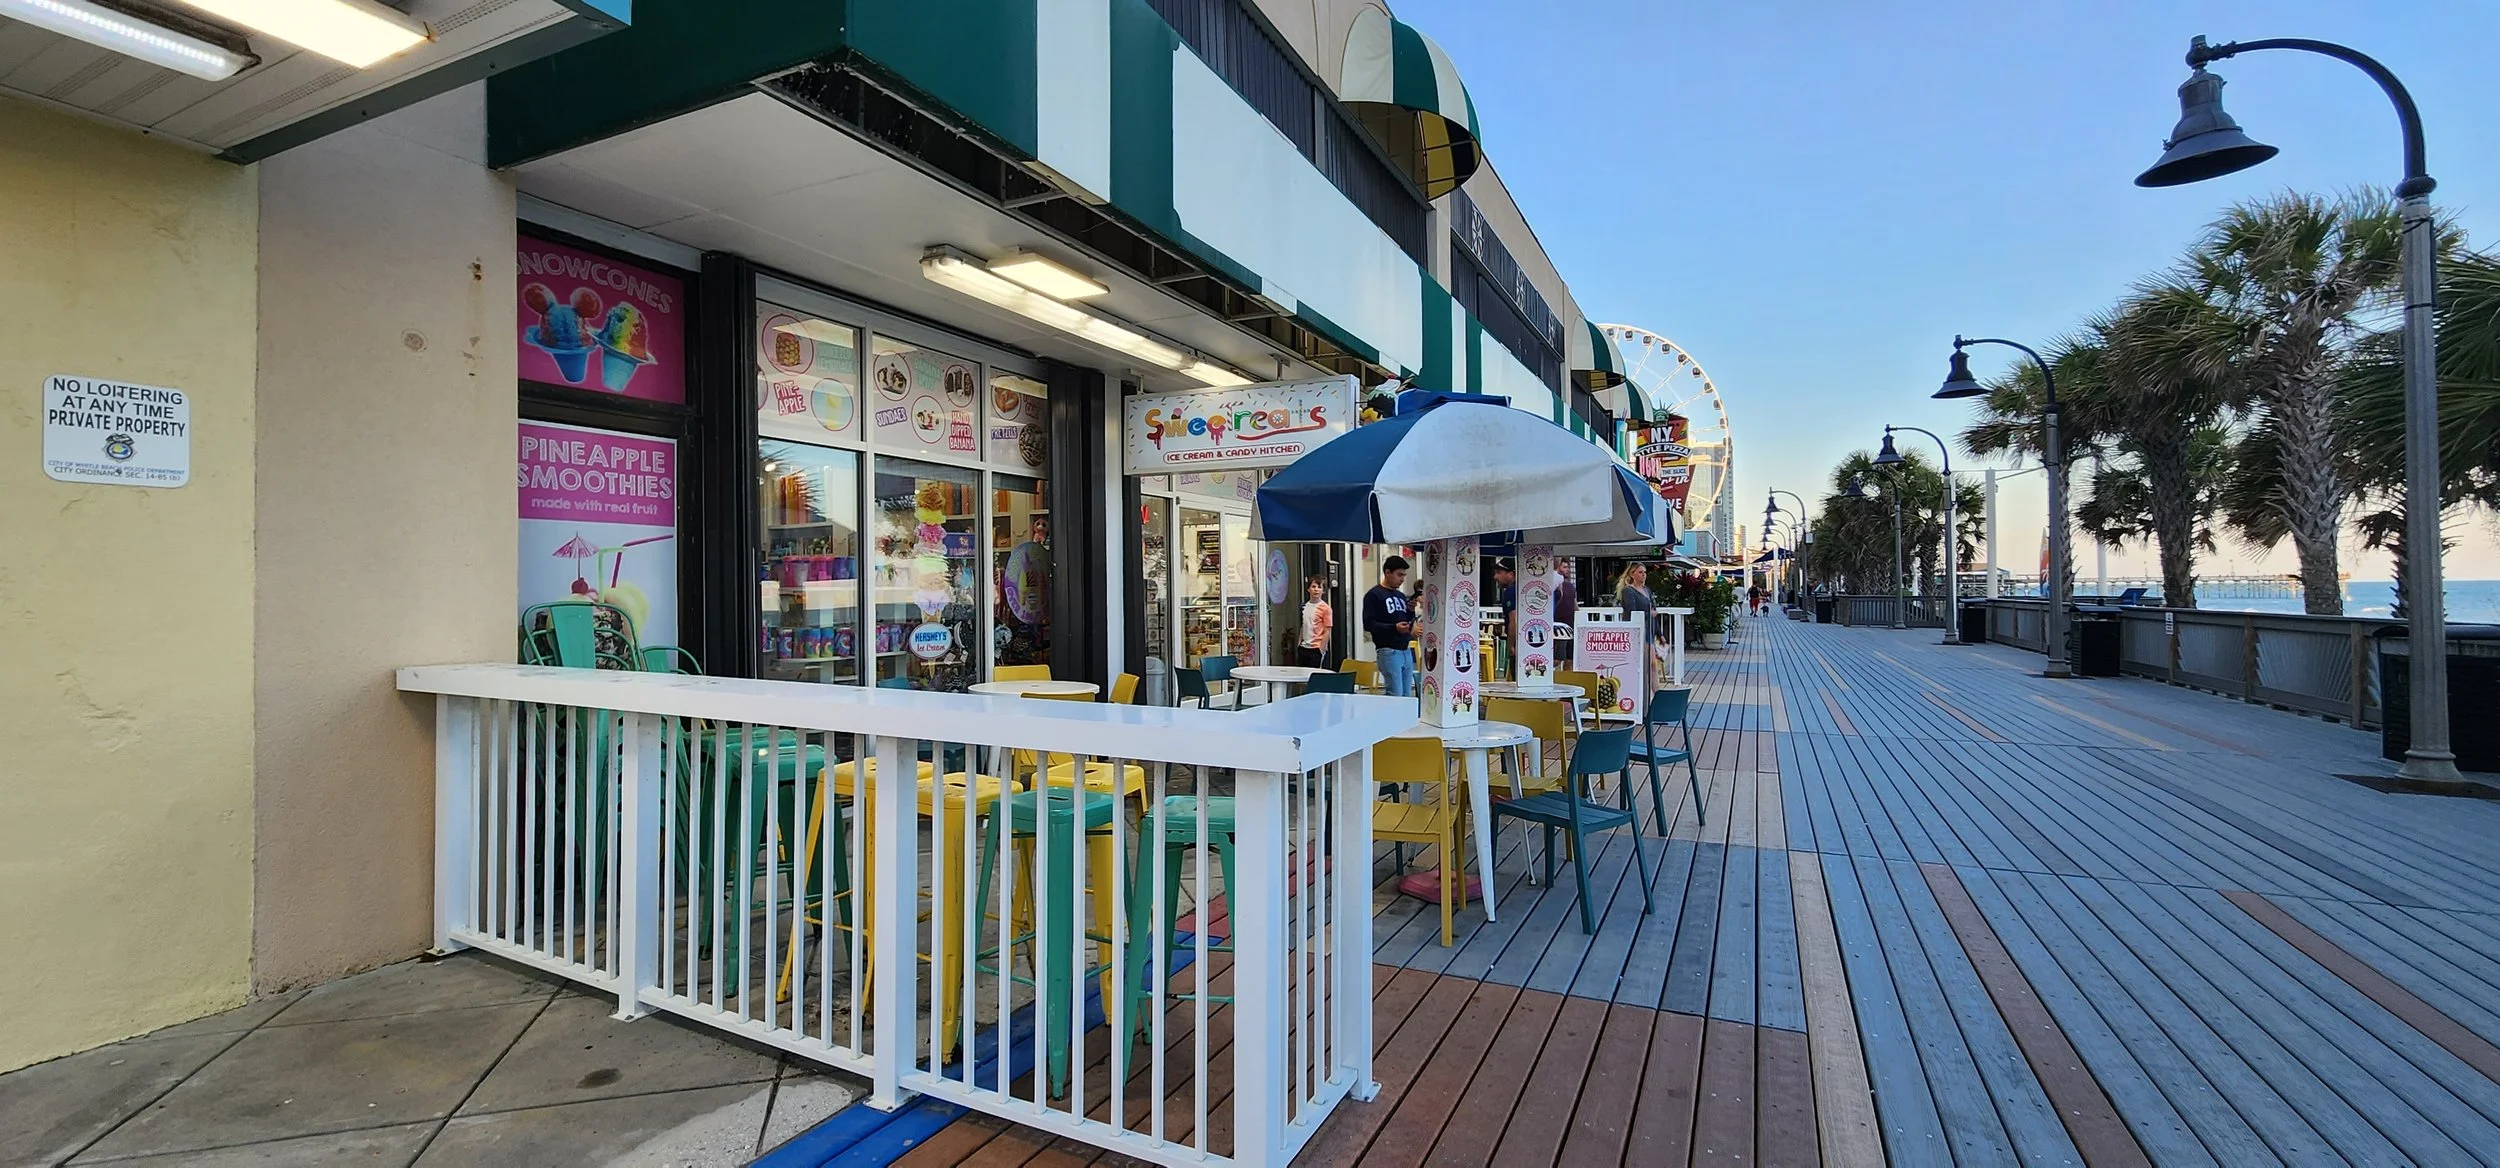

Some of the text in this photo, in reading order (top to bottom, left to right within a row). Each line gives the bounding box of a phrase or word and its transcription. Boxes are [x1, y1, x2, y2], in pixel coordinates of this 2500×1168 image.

[53, 377, 183, 405] NO LOITERING
[774, 380, 800, 399] PINE-
[61, 395, 174, 419] AT ANY TIME
[779, 396, 806, 416] APPLE
[49, 409, 186, 437] PRIVATE PROPERTY
[875, 407, 907, 427] SUNDAES
[949, 437, 975, 450] BANANA
[1651, 426, 1674, 443] N.Y.
[521, 436, 666, 474] PINEAPPLE
[1166, 444, 1300, 461] ICE CREAM & CANDY KITCHEN
[1664, 445, 1689, 455] PIZZA
[518, 463, 673, 499] SMOOTHIES
[531, 497, 658, 515] made with real fruit
[915, 631, 947, 643] HERSHEY'S
[1588, 631, 1629, 641] PINEAPPLE
[927, 643, 946, 651] Cream
[1586, 642, 1630, 651] SMOOTHIES
